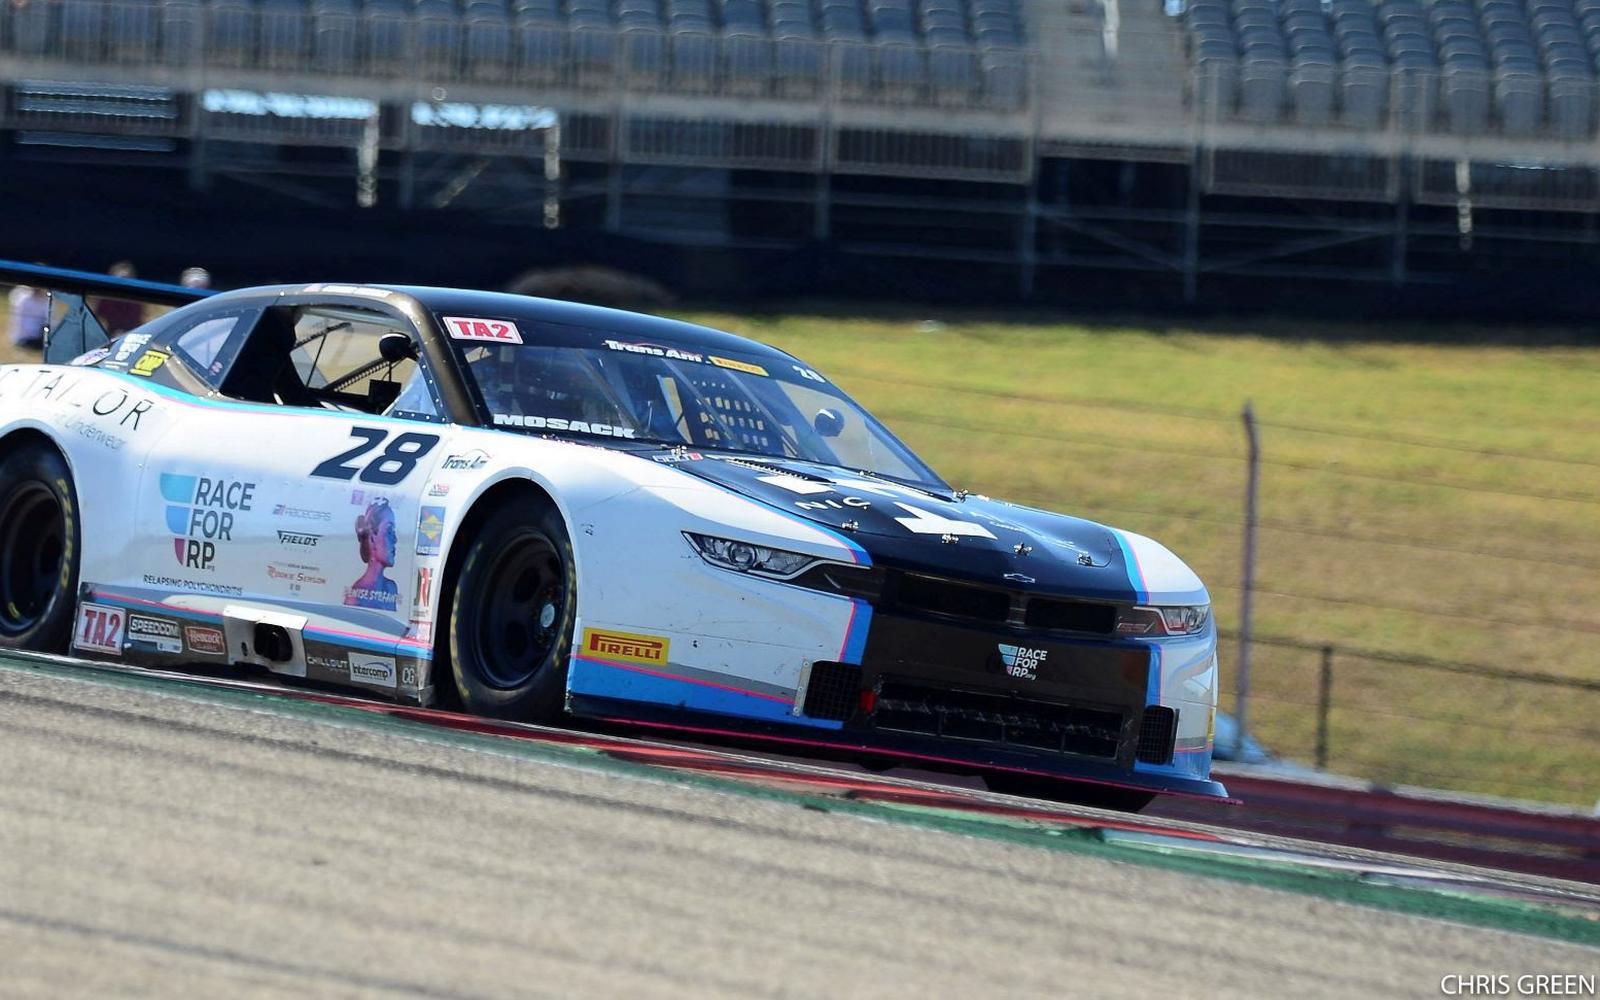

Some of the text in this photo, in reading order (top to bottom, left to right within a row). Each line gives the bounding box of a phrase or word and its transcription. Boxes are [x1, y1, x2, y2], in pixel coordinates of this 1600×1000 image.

[453, 320, 513, 340] TA2
[604, 339, 703, 363] Trans Am
[493, 413, 635, 439] MOSACK
[310, 426, 440, 485] 28
[441, 455, 471, 470] Trans
[195, 477, 256, 511] RACE
[794, 496, 871, 510] NIC
[189, 508, 234, 541] FOR
[277, 530, 323, 546] FIELDS
[143, 574, 181, 587] RELAPSING
[83, 609, 121, 648] TA2
[130, 618, 179, 639] SPEEDCOM
[590, 633, 663, 660] PIRELLI
[1017, 647, 1048, 661] RACE
[1015, 657, 1038, 670] FOR
